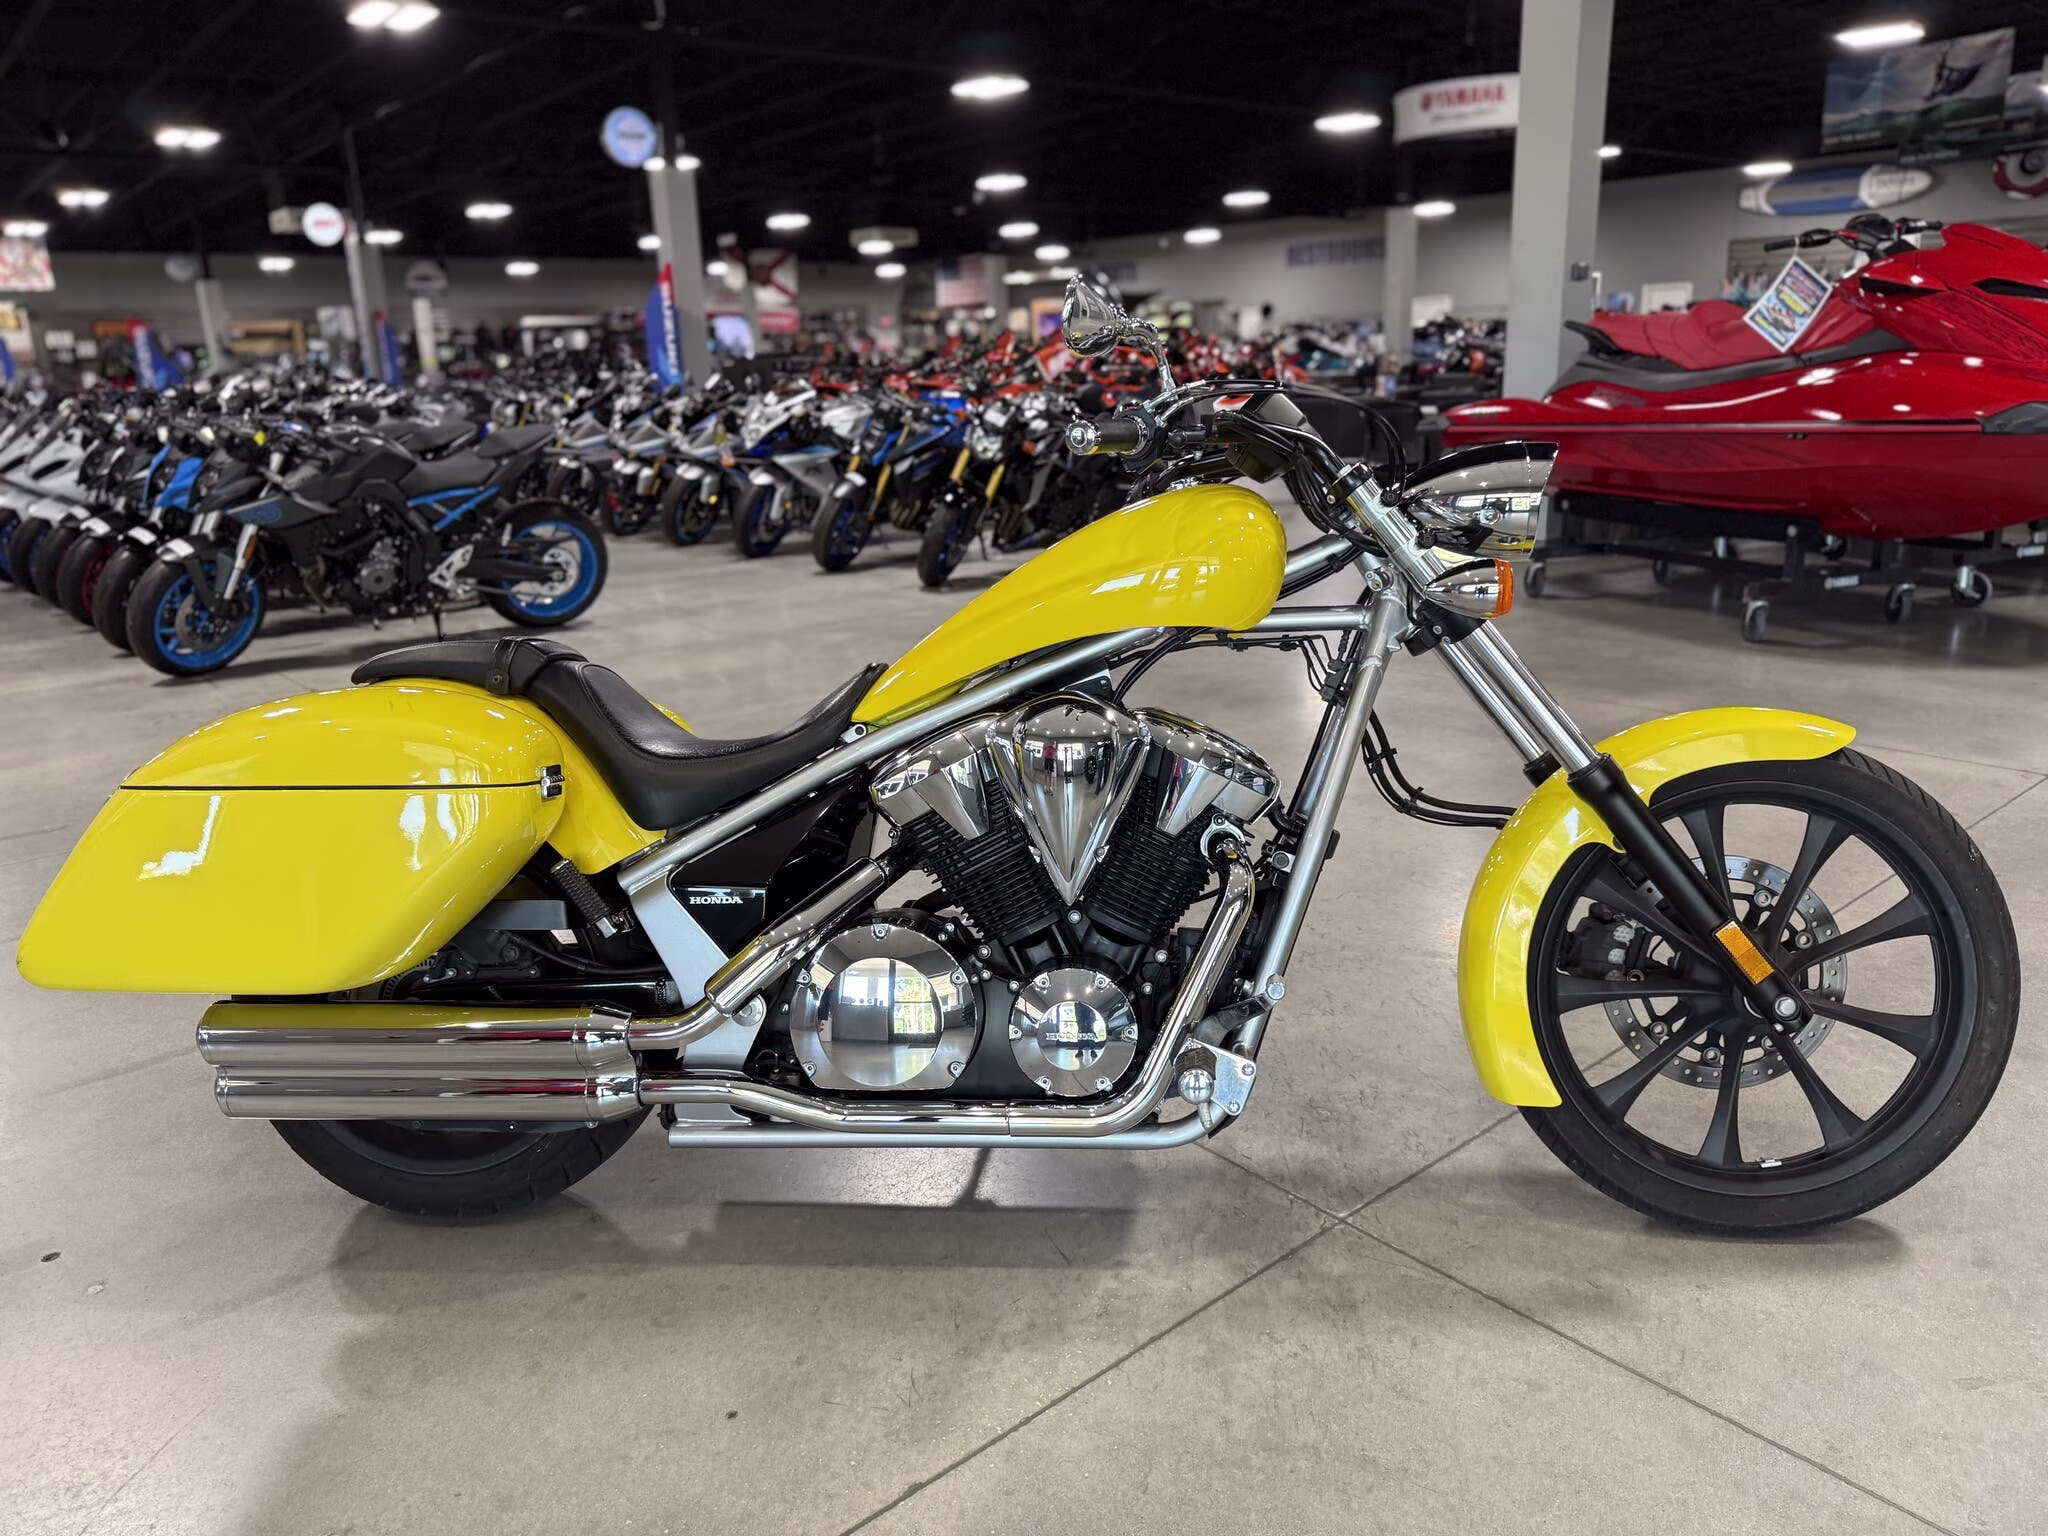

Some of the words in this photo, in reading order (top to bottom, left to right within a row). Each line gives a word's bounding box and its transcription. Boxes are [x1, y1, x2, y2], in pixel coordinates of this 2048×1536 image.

[1434, 83, 1504, 107] YAMAHA
[689, 896, 743, 905] HONDA
[1045, 1031, 1099, 1041] HONDA
